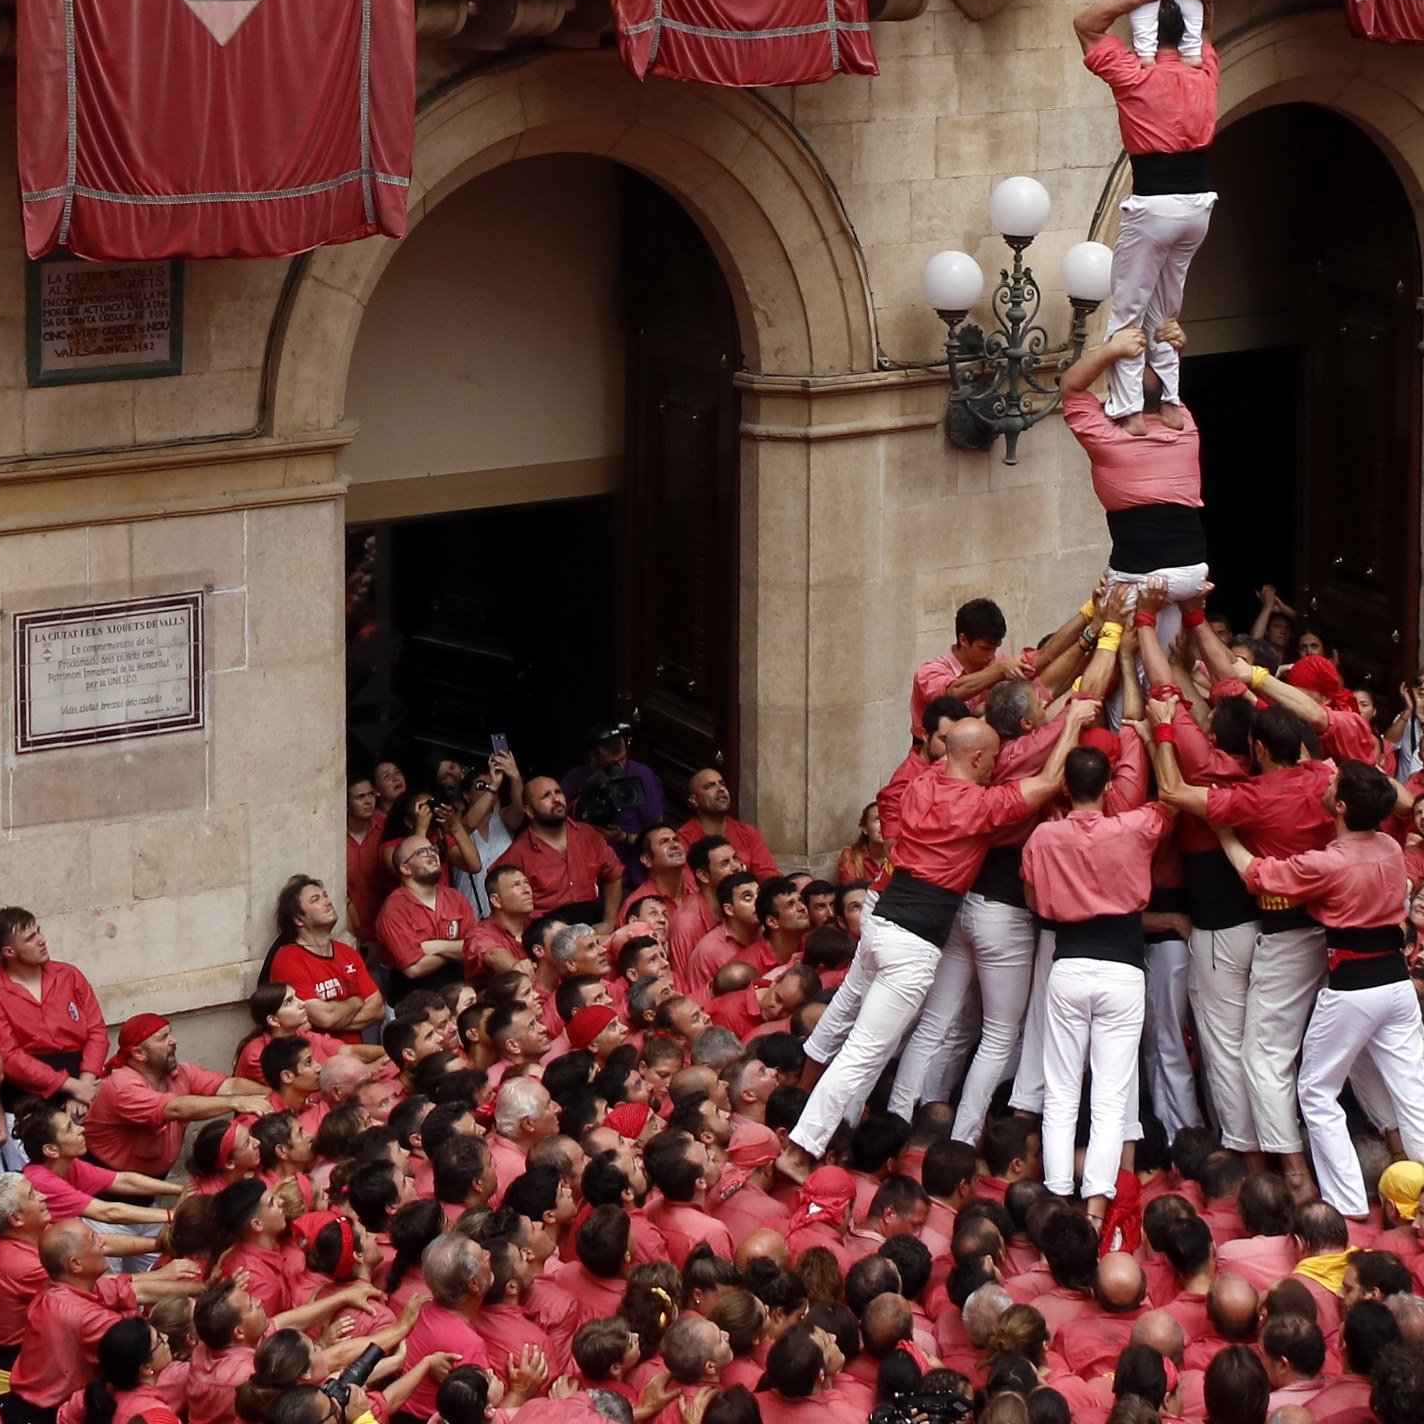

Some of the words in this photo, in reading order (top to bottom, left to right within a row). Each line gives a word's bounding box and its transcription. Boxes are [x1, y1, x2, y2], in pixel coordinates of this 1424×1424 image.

[48, 274, 62, 284] LA
[48, 284, 72, 295] ALS
[34, 633, 47, 643] LA
[48, 630, 79, 641] CIUTAT
[85, 627, 103, 637] ELS
[107, 622, 145, 634] XIQUETS
[146, 620, 158, 629] DE
[159, 616, 185, 627] VALLS
[71, 645, 81, 655] En
[108, 675, 137, 686] UNESCO
